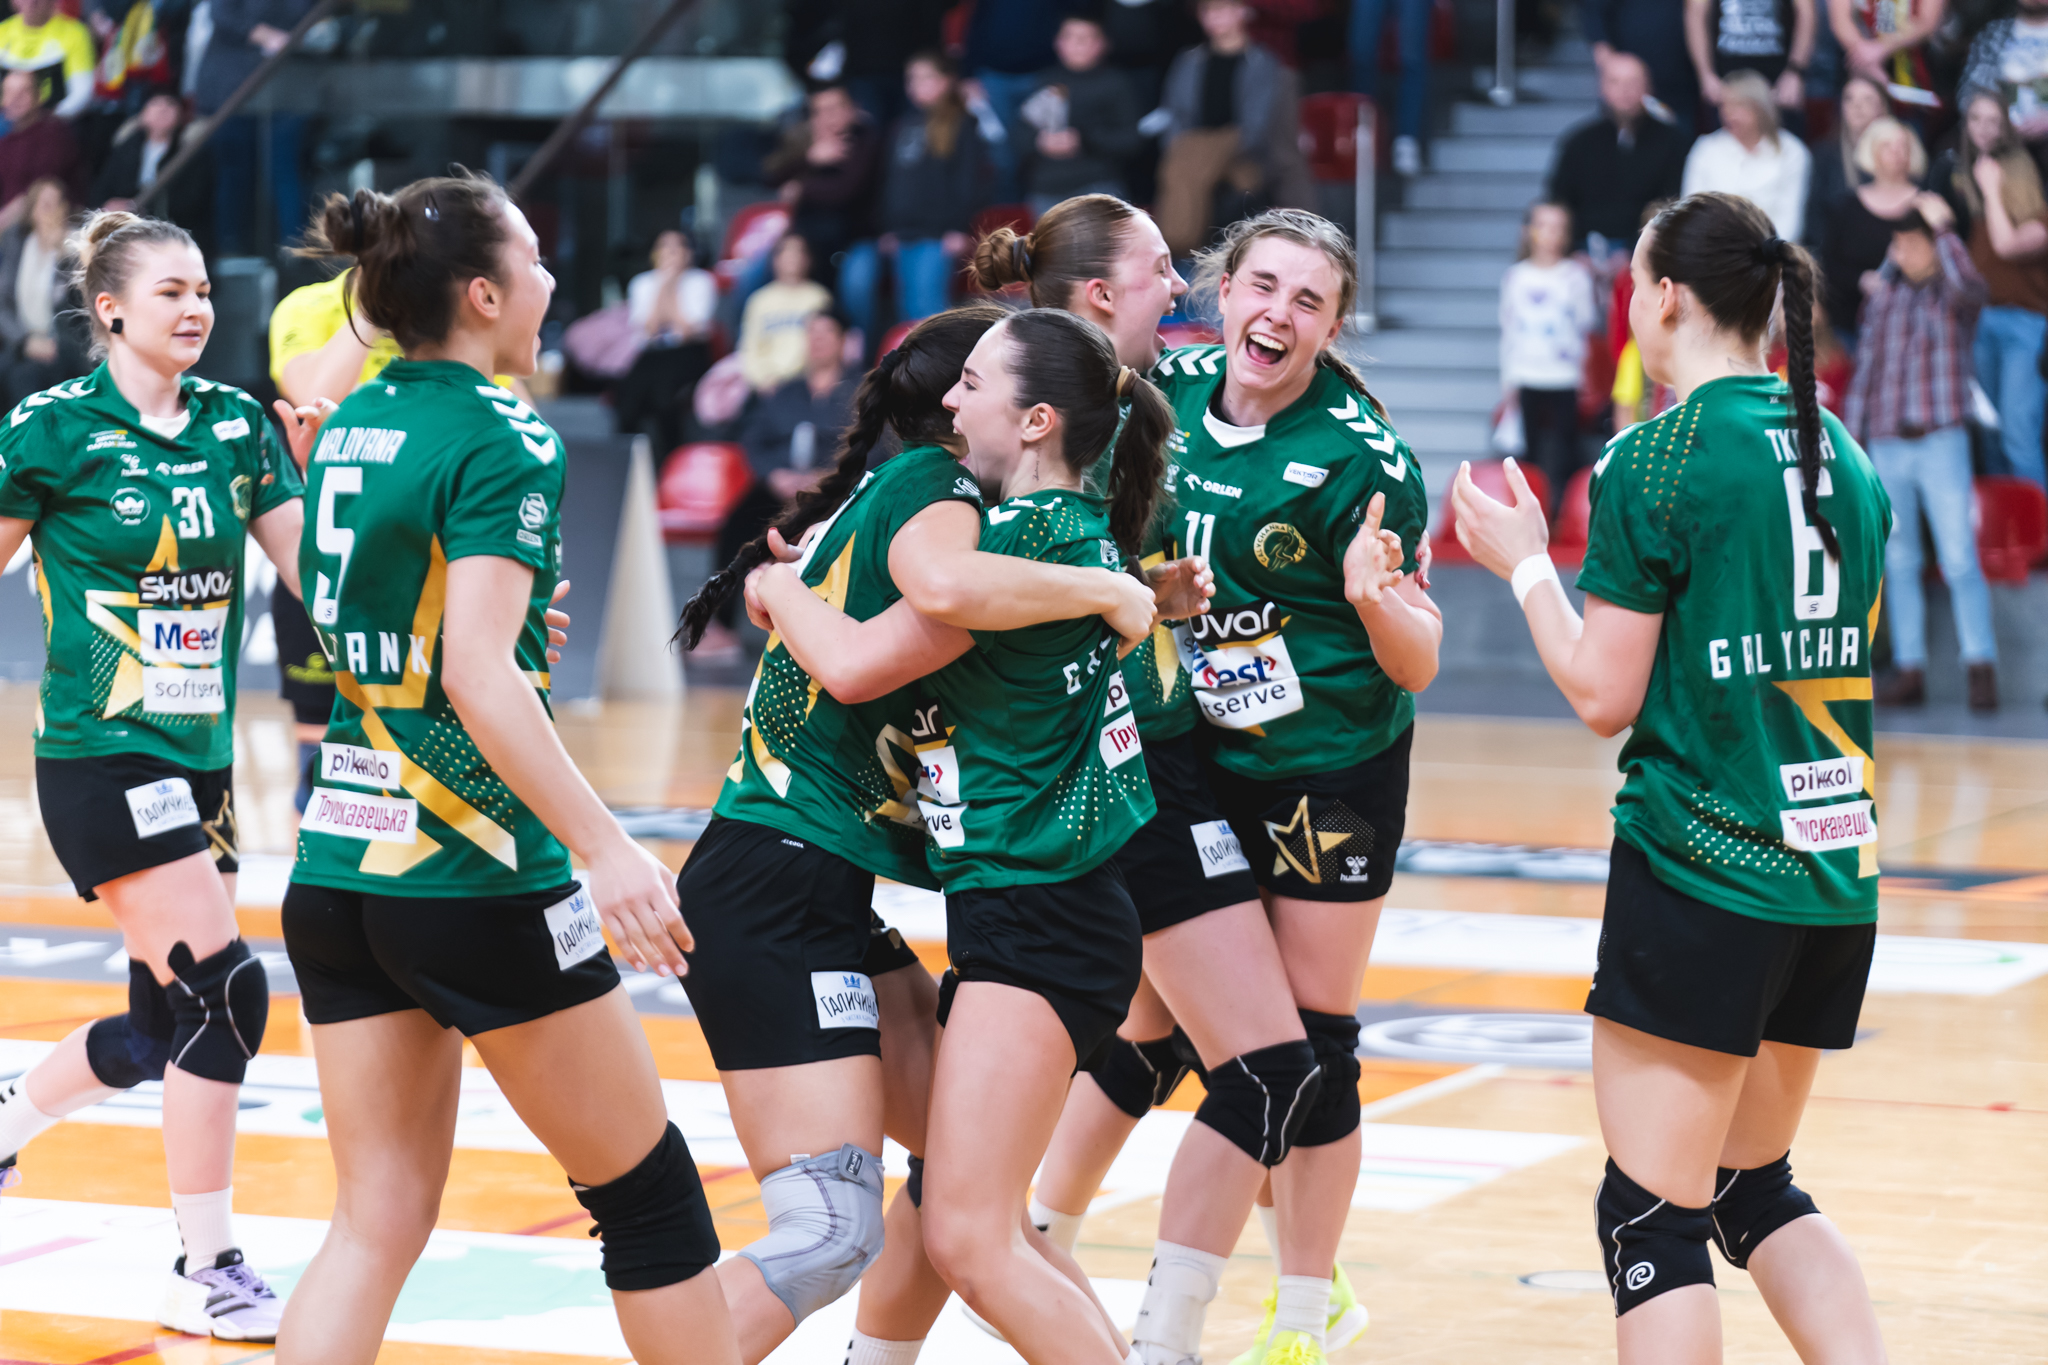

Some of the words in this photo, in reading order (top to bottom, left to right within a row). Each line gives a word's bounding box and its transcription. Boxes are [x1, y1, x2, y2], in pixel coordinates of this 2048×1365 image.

[172, 487, 215, 539] 31
[1202, 480, 1243, 499] ORLEN
[313, 466, 363, 625] 5
[1185, 510, 1216, 566] 11
[1783, 466, 1840, 621] 6
